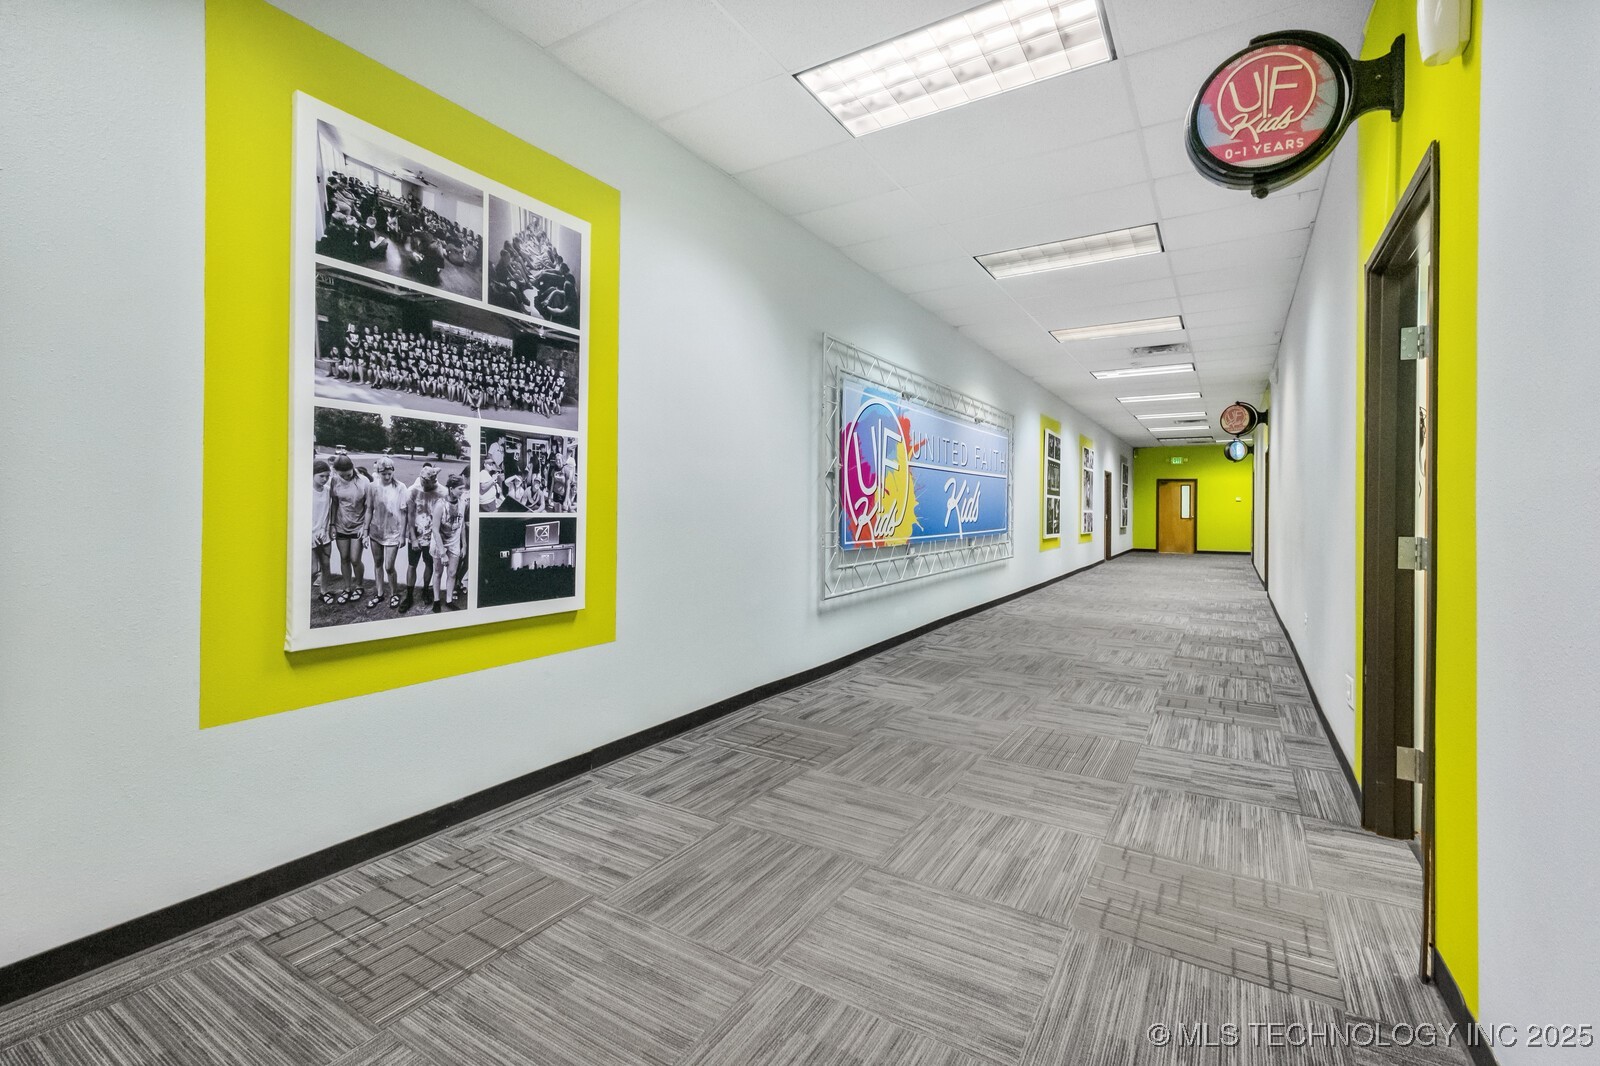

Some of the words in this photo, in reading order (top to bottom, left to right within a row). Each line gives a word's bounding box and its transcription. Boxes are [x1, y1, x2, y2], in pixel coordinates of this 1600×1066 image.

[1229, 105, 1295, 143] Kids
[1225, 147, 1247, 159] 0-1
[1253, 137, 1305, 154] YEARS
[911, 431, 968, 467] UNITED
[975, 446, 1006, 471] FAITH
[854, 497, 899, 548] Kids
[944, 477, 981, 539] Kids
